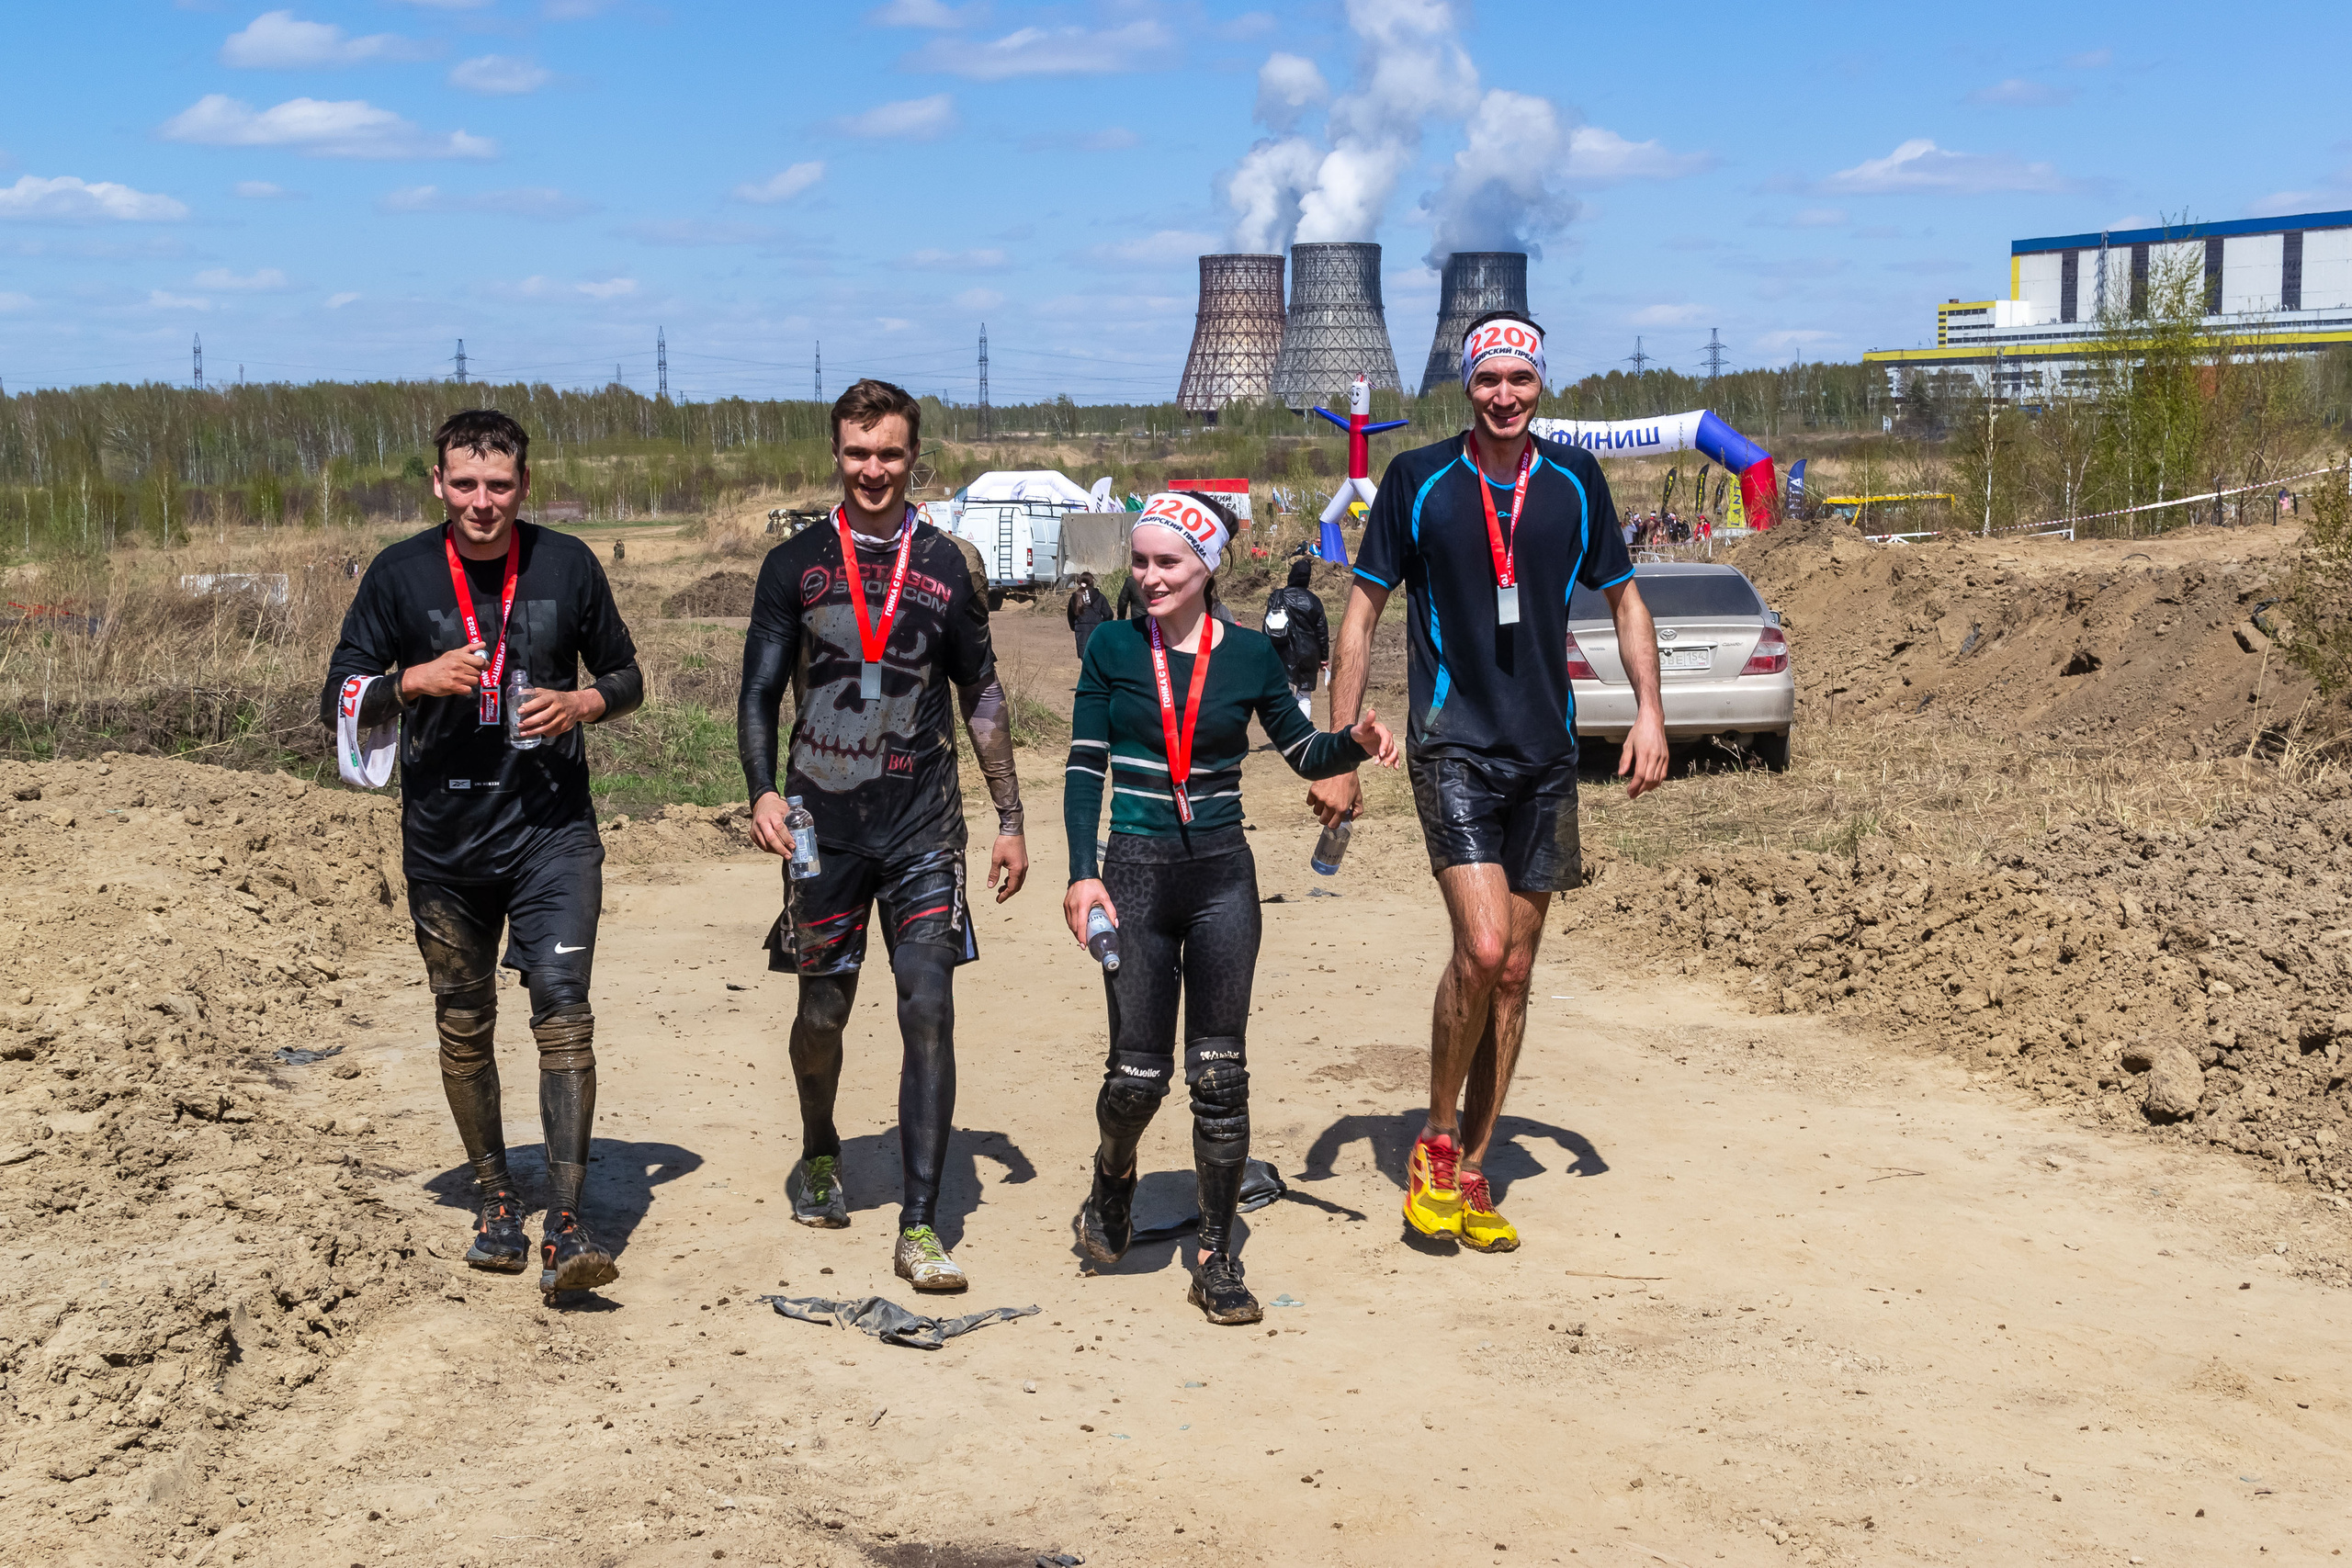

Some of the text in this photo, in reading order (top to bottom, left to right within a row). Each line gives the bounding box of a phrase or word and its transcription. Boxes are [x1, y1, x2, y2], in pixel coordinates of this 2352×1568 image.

[1470, 327, 1537, 360] 2207
[1549, 426, 1661, 450] ФИНИШ
[1521, 452, 1530, 469] 2023
[1731, 477, 1742, 526] LANT
[1143, 499, 1217, 543] 2207
[885, 589, 899, 616] ГОНКА
[466, 615, 478, 637] 2023
[1159, 678, 1171, 708] ГОНКА
[1127, 1066, 1160, 1077] Mueller
